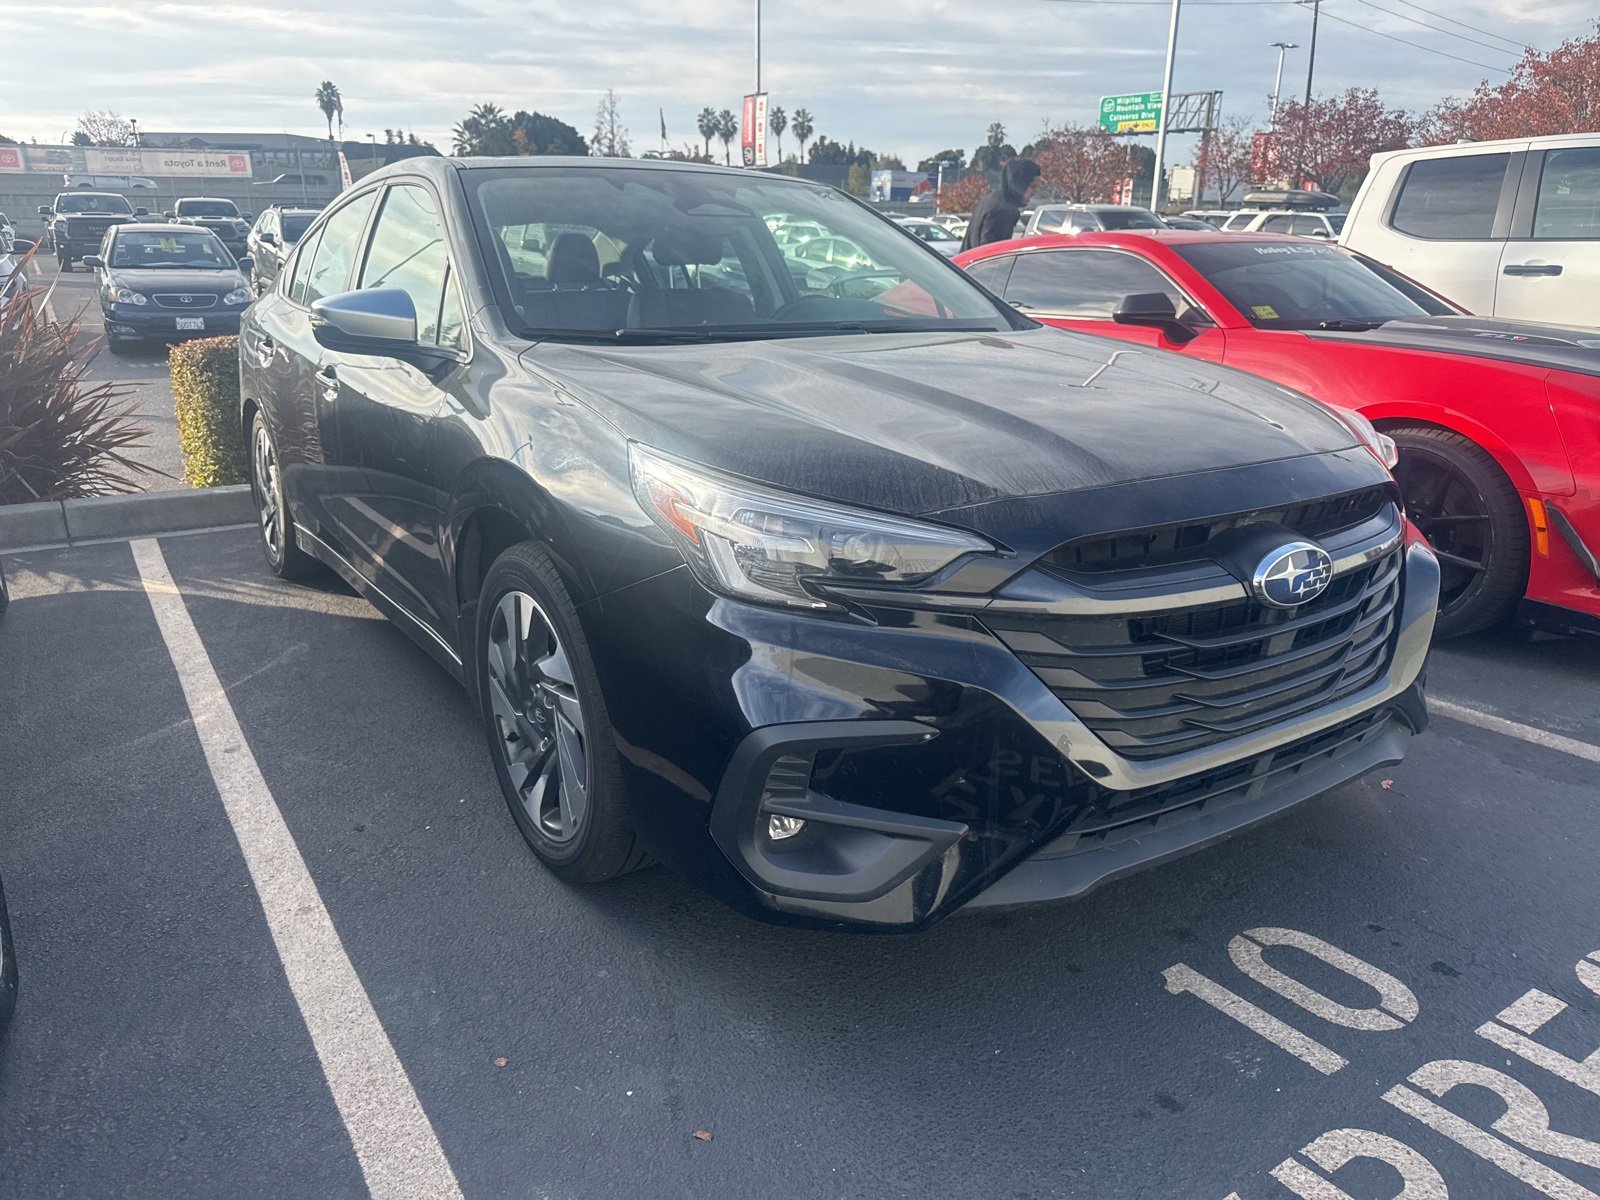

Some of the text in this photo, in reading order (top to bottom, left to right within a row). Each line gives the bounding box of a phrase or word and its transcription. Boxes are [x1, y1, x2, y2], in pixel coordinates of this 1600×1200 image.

[1117, 97, 1142, 105] Milpitas
[1116, 104, 1145, 112] Mountain
[1109, 111, 1156, 121] Calaveras Blvd
[1159, 925, 1421, 1076] 10
